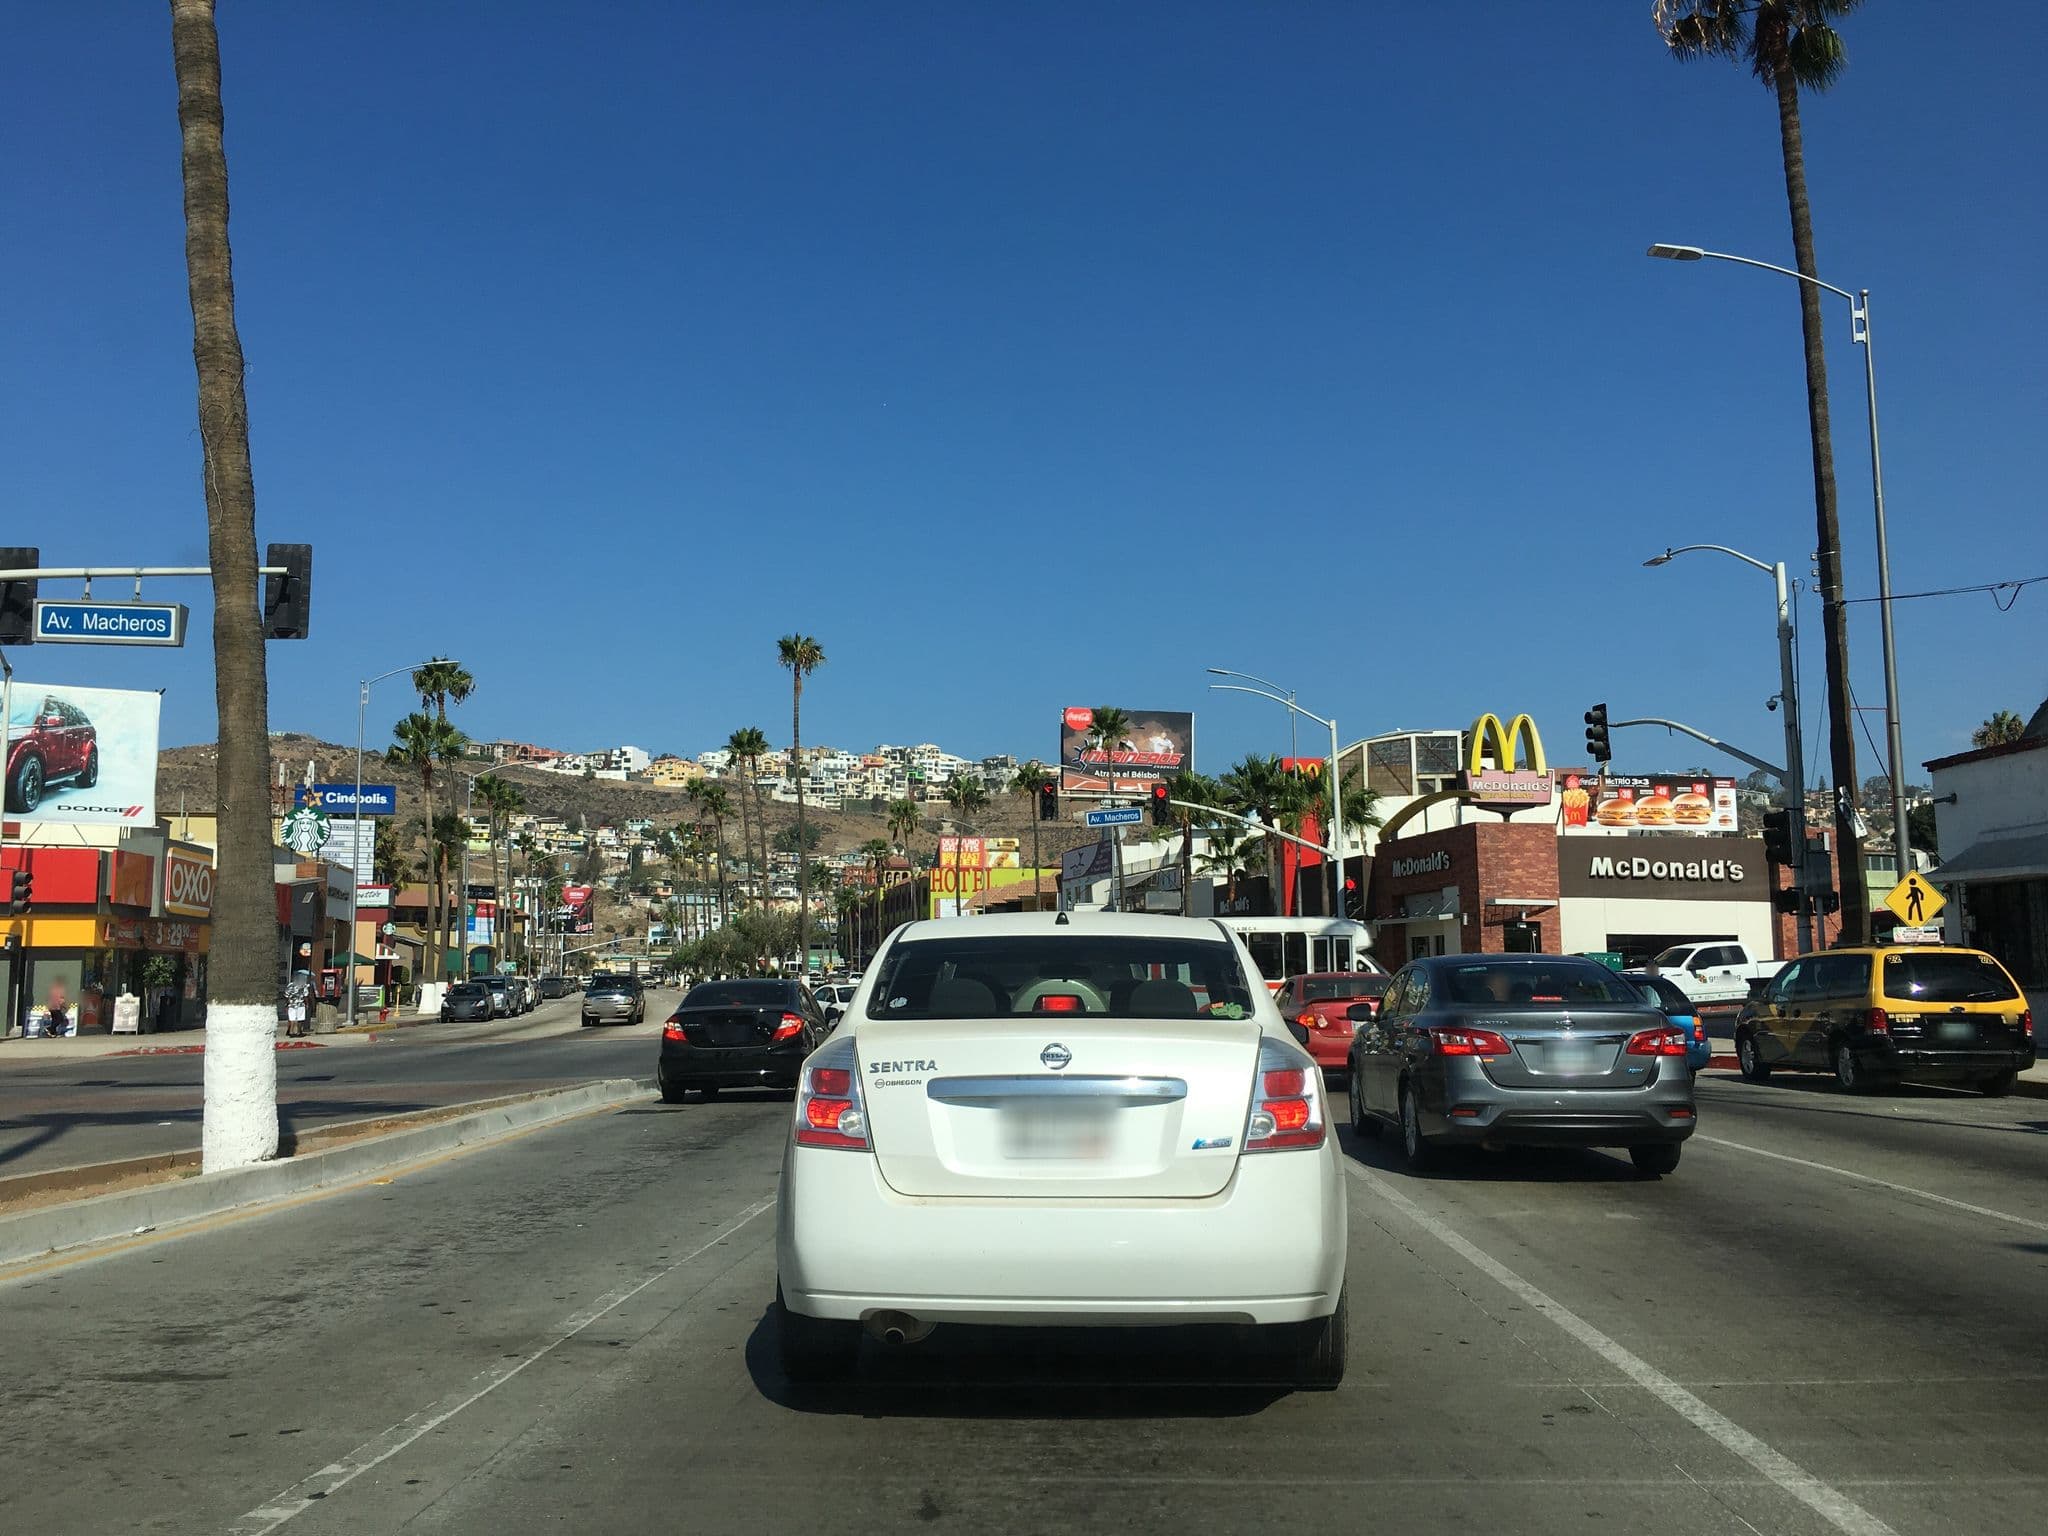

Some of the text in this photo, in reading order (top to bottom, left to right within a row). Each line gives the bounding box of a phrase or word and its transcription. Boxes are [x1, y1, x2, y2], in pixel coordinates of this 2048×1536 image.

[46, 611, 166, 632] Av. Macheros
[1122, 770, 1129, 778] el
[1472, 781, 1549, 792] McDonald's
[57, 805, 129, 813] DODGE
[1090, 813, 1139, 823] Av. Macheros
[1393, 852, 1450, 877] McDonald's
[1590, 856, 1744, 881] McDonald's
[172, 864, 211, 902] OXXO
[869, 1060, 938, 1074] SENTRA
